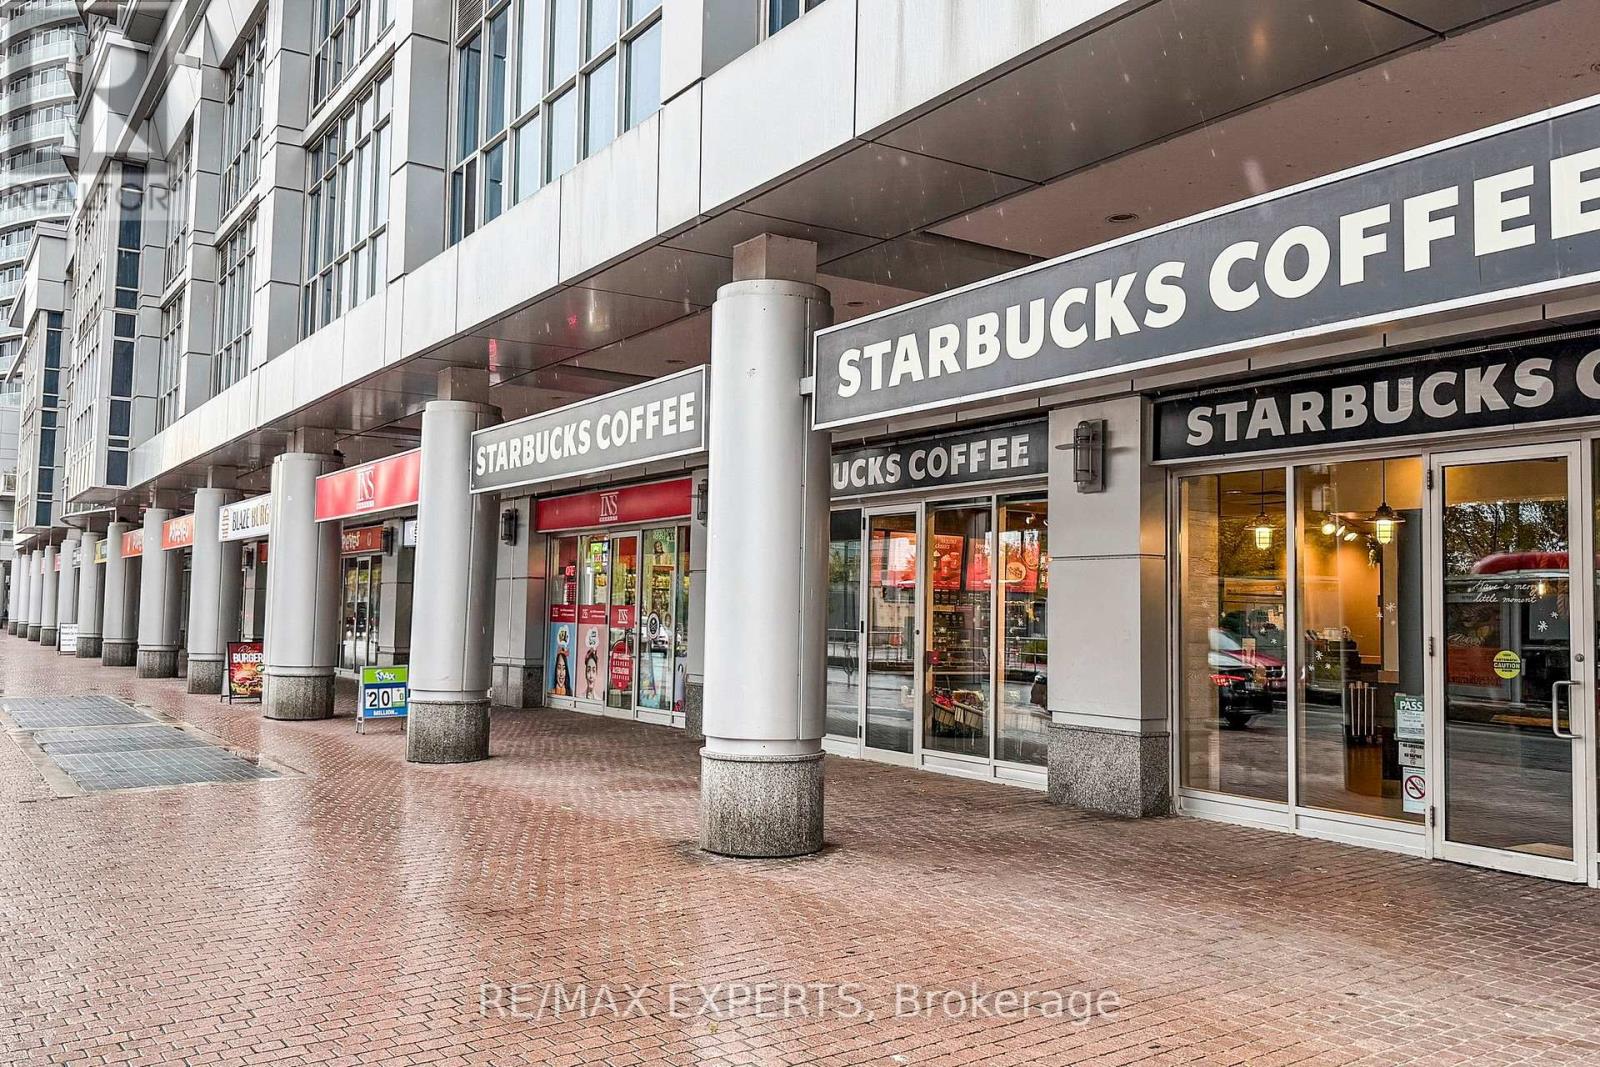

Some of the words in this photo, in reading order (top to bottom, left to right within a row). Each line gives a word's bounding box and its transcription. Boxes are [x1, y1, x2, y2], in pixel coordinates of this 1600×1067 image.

[837, 261, 1187, 398] STARBUCKS
[1209, 147, 1600, 312] COFFEE
[1186, 357, 1554, 447] STARBUCKS
[476, 420, 591, 476] STARBUCKS
[596, 391, 696, 450] COFFEE
[832, 453, 901, 490] UCKS
[908, 433, 1030, 481] COFFEE
[232, 508, 249, 531] BLAZE
[1472, 579, 1500, 590] Have
[1473, 591, 1499, 603] little
[1502, 595, 1538, 604] moment
[232, 652, 264, 663] BURGER
[1400, 700, 1423, 711] PASS
